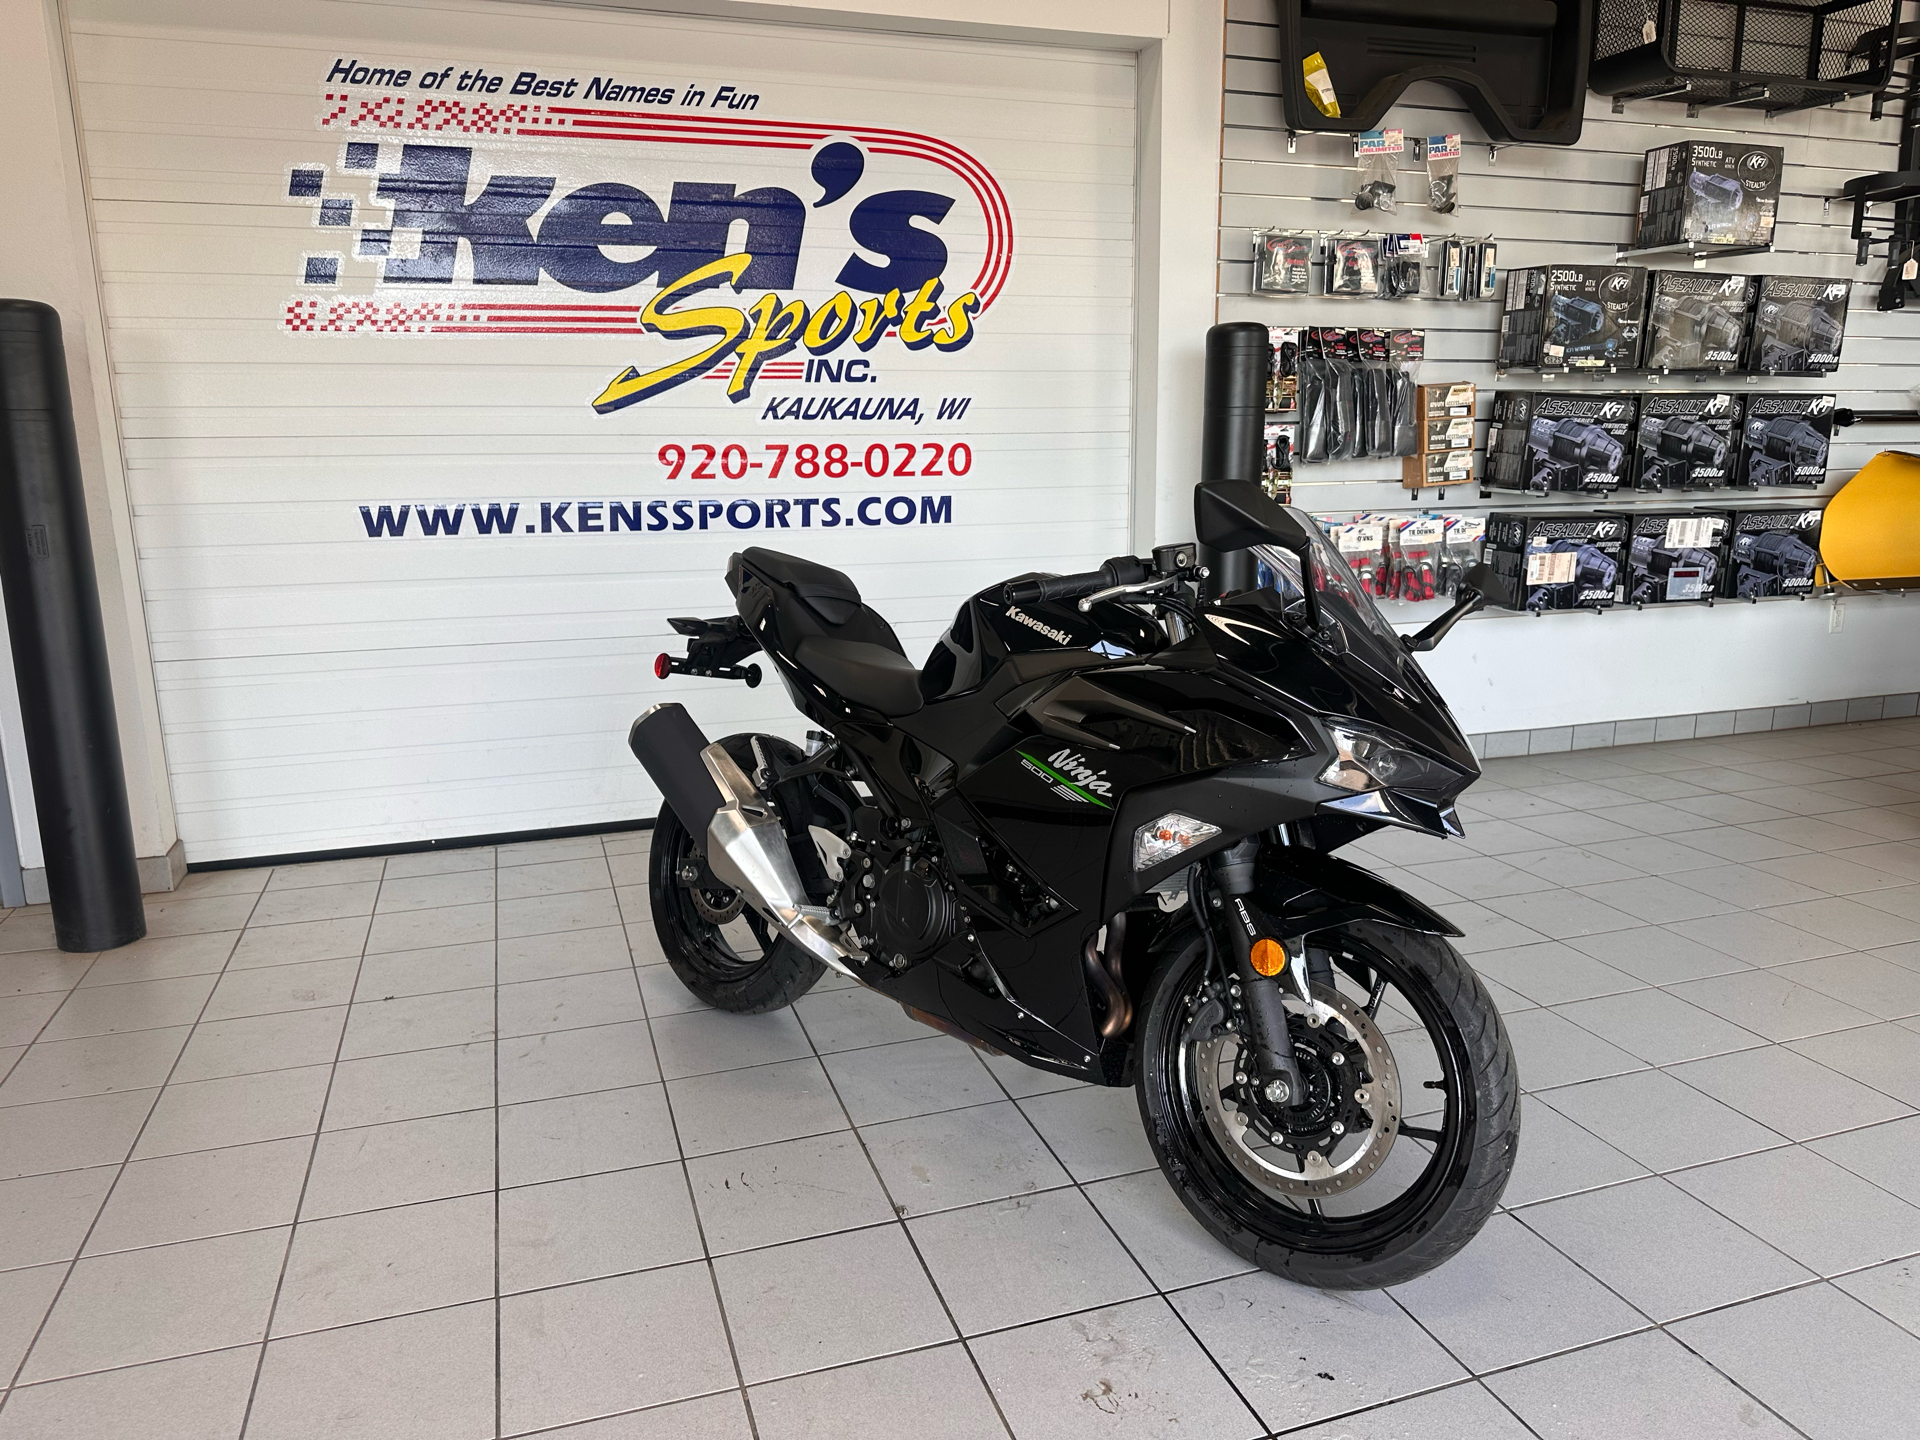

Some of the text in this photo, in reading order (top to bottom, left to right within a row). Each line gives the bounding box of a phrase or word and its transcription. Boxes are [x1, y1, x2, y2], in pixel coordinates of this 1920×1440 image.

[325, 58, 761, 111] Home of the Best Names in Fun
[1359, 145, 1403, 154] UNLIMITED
[1428, 151, 1460, 160] UNLIMITED
[1692, 145, 1723, 159] 3500LB
[1691, 158, 1717, 168] SYNTHETIC
[1725, 156, 1736, 165] ATV
[1745, 179, 1766, 188] STEALTH
[383, 141, 957, 294] ken's
[1551, 270, 1583, 283] 2500LB
[1657, 275, 1722, 293] ASSAULT
[1550, 283, 1577, 291] SYNTHETIC
[1762, 280, 1826, 299] ASSAULT
[1607, 302, 1628, 310] STEALTH
[591, 252, 984, 416] Sports
[1704, 350, 1738, 361] 3500LB
[1808, 353, 1839, 364] 5000LB
[804, 359, 877, 383] INC.
[761, 396, 972, 426] KAUKAUNA, WI
[1534, 397, 1602, 417] ASSAULT
[1643, 396, 1707, 415] ASSAULT
[1748, 397, 1810, 415] ASSAULT
[657, 442, 972, 480] 920-788-0220
[1585, 473, 1620, 483] 2500LB
[1692, 468, 1725, 478] 3500LB
[1795, 466, 1826, 476] 5000LB
[358, 494, 952, 538] WWW.KENSSPORTS.COM
[1737, 514, 1799, 531] ASSAULT
[1417, 528, 1436, 536] DOWNS
[1528, 521, 1596, 539] ASSAULT
[1782, 578, 1813, 588] 5000LB
[1580, 590, 1615, 600] 2500LB
[1005, 605, 1073, 646] Kawasaki
[1020, 758, 1054, 784] 500
[1047, 748, 1113, 798] Ninja
[1234, 898, 1257, 937] ABS
